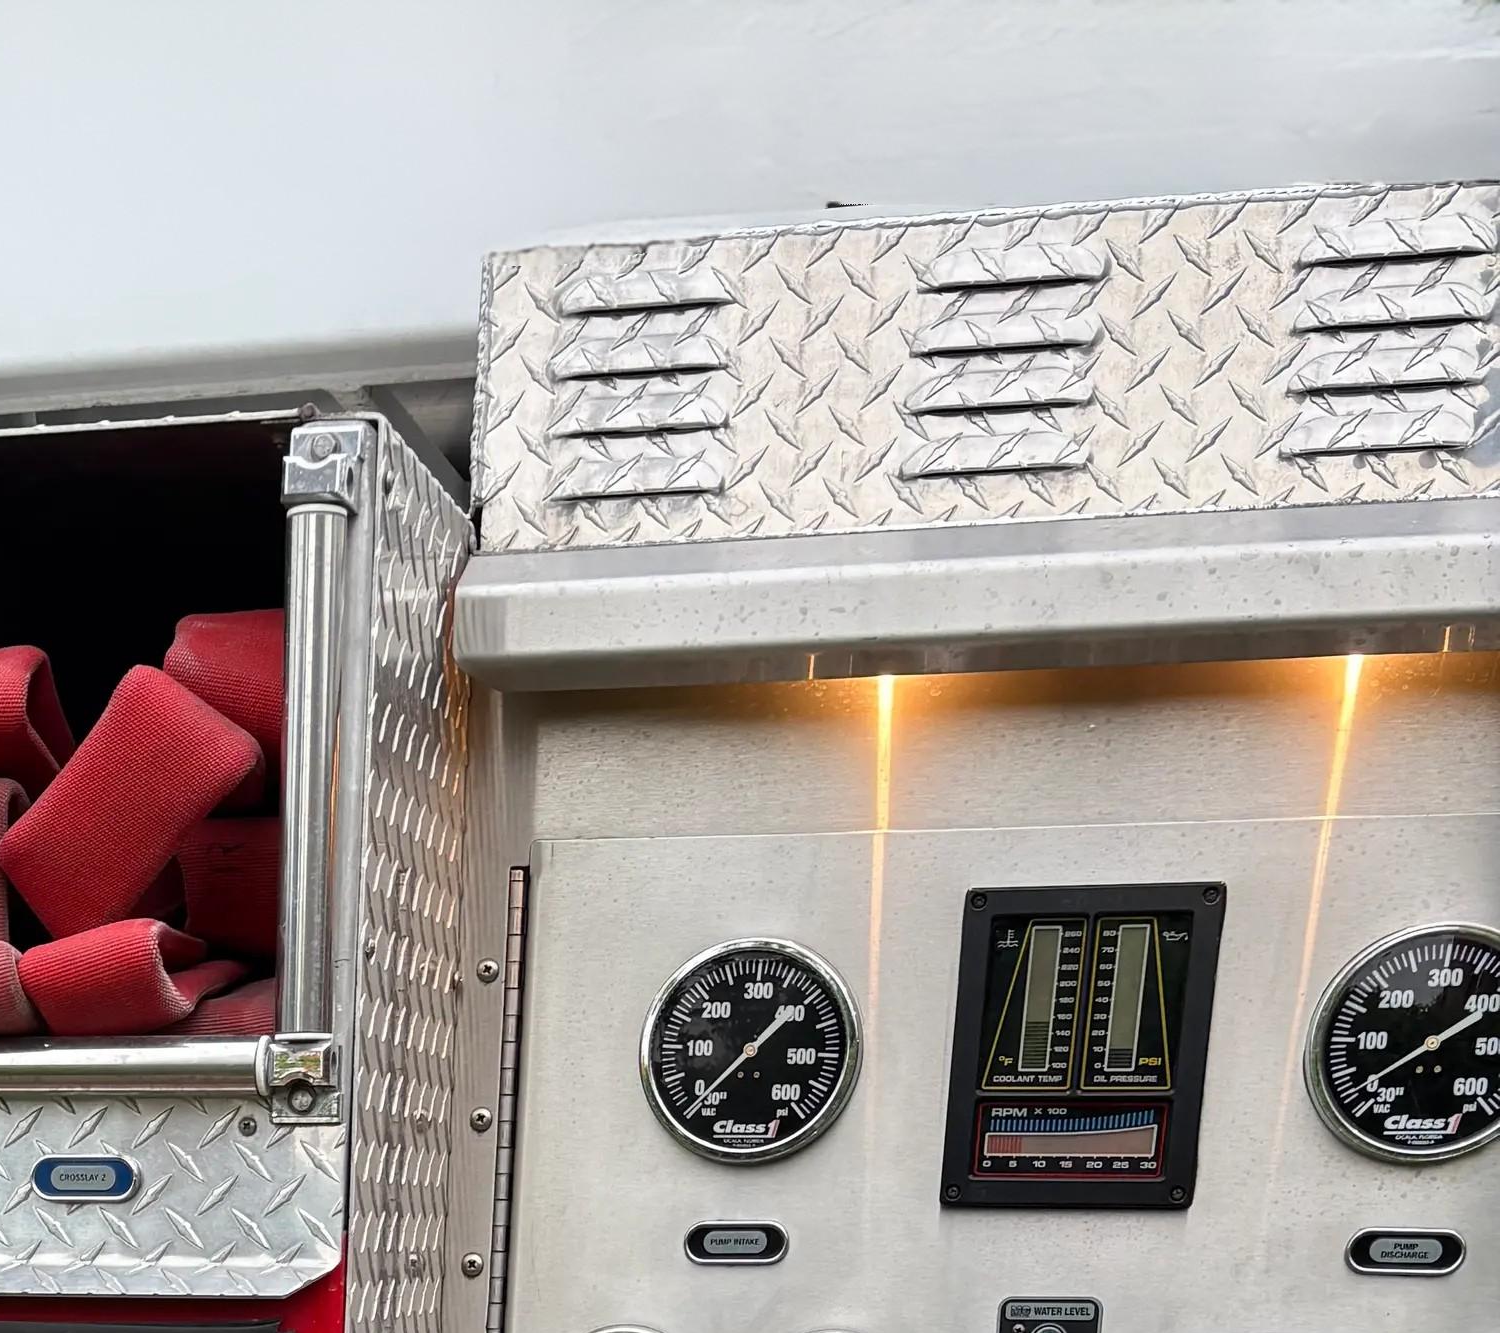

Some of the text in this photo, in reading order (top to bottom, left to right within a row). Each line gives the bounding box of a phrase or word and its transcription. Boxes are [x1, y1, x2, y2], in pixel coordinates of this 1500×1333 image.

[1428, 969, 1463, 986] 300
[744, 982, 773, 999] 300
[1378, 990, 1414, 1008] 200
[702, 1002, 730, 1018] 200
[1357, 1032, 1388, 1049] 100
[687, 1041, 712, 1056] 100
[787, 1048, 815, 1064] 500
[993, 1075, 1035, 1083] COOLANT
[1094, 1075, 1107, 1083] OIL
[772, 1084, 800, 1100] 600
[1453, 1078, 1488, 1095] 600
[702, 1108, 716, 1116] VAC
[777, 1108, 788, 1117] psi
[992, 1108, 1027, 1117] RPM
[1373, 1104, 1390, 1113] VAC
[1463, 1102, 1476, 1113] psi
[1086, 1161, 1102, 1169] 20
[1381, 1251, 1428, 1259] DISCHARGE
[1034, 1307, 1062, 1316] WATER
[1065, 1307, 1091, 1316] LEVEL
